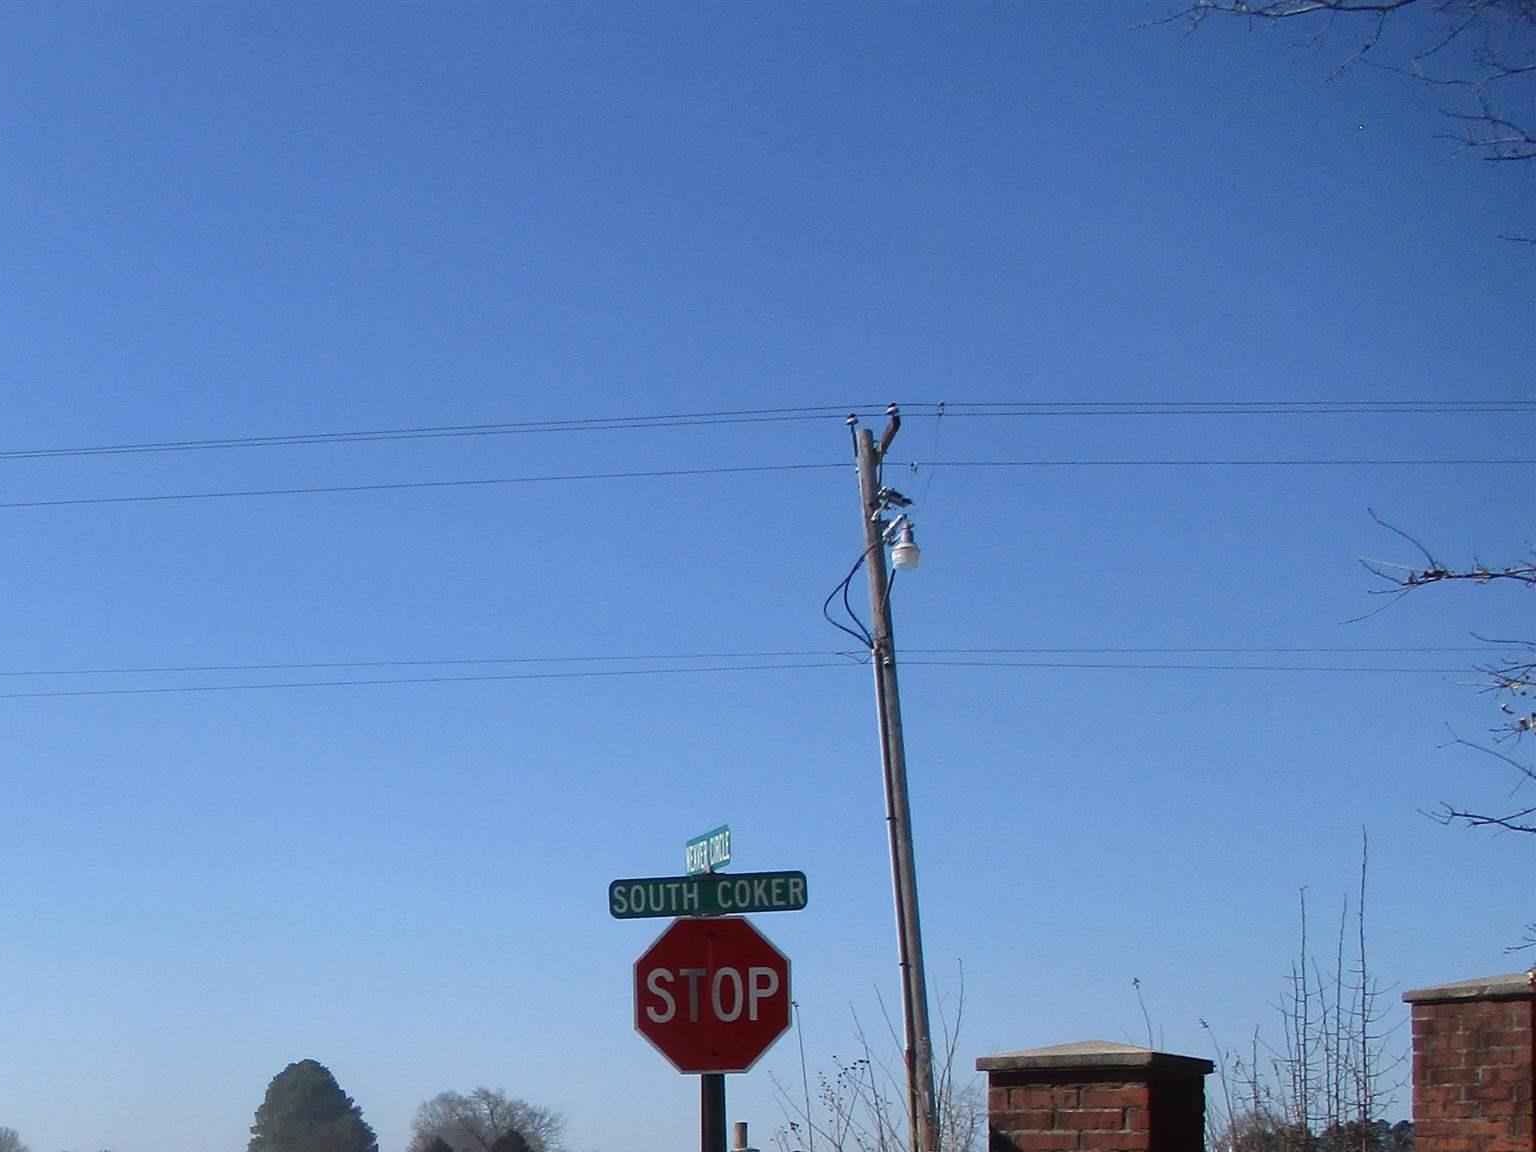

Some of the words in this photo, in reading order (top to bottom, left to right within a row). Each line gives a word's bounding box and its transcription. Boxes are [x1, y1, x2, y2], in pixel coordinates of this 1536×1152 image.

[613, 883, 699, 913] SOUTH
[717, 878, 805, 908] COKER
[646, 967, 779, 1024] STOP
